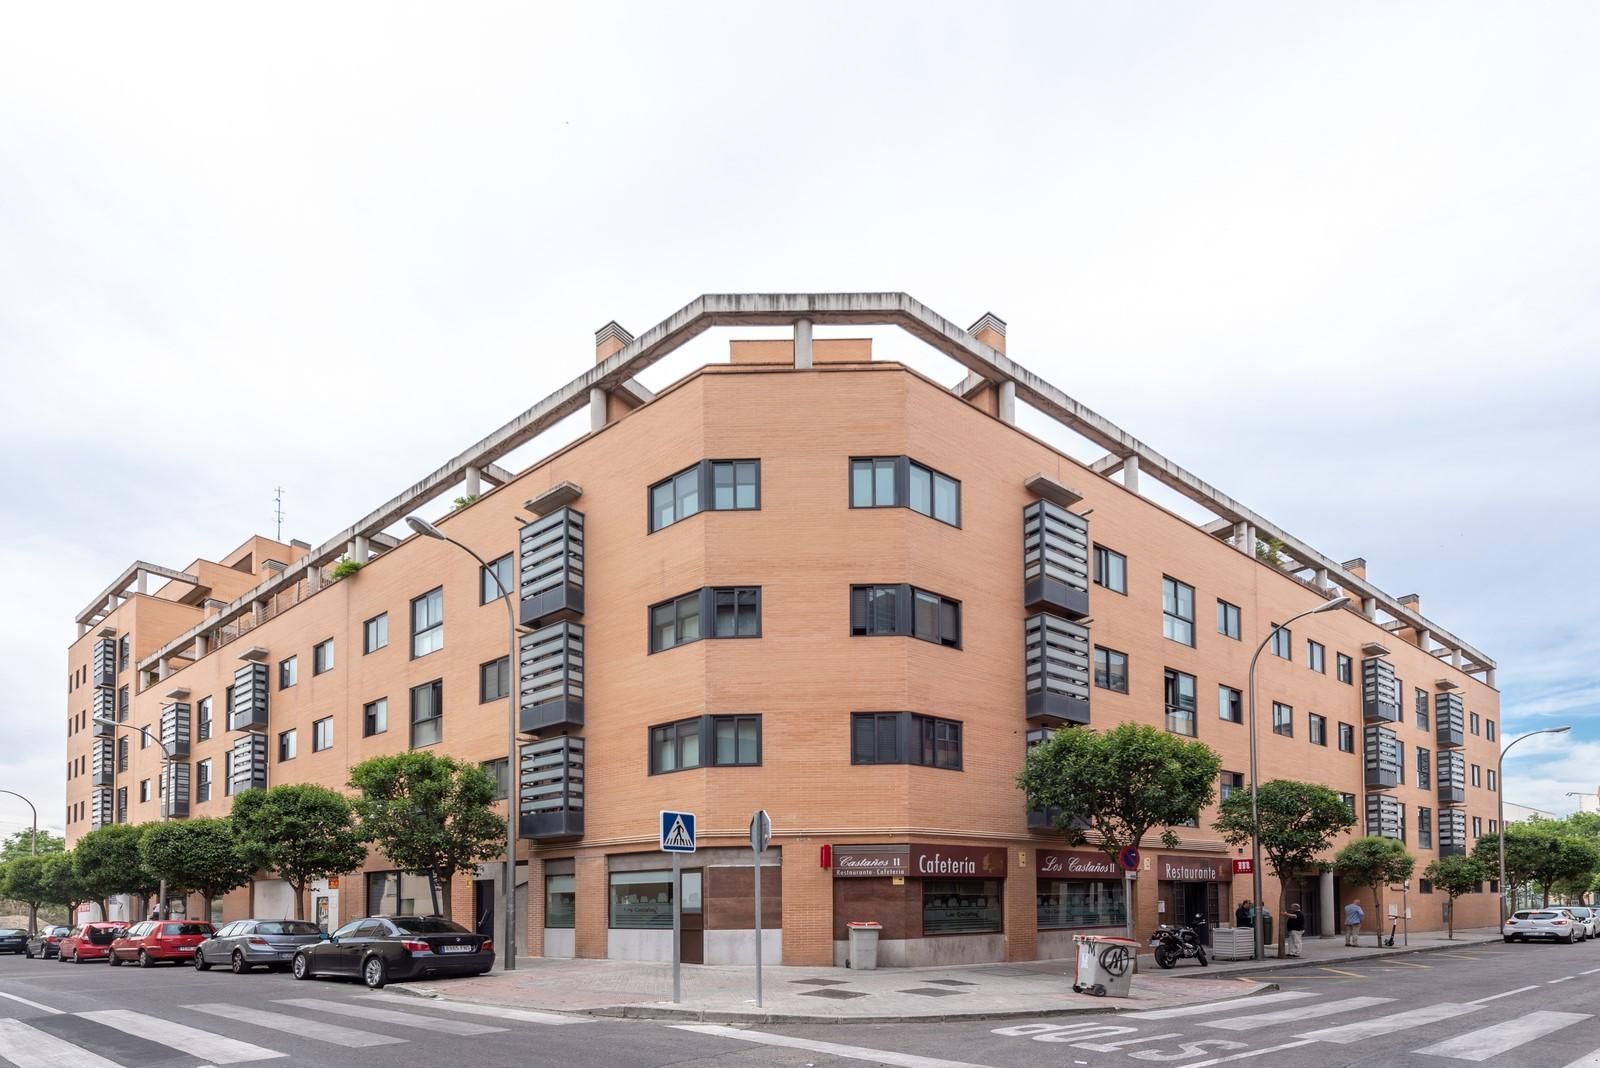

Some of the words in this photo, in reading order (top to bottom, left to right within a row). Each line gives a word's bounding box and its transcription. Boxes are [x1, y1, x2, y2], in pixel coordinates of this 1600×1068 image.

[839, 855, 889, 867] Castaños
[919, 853, 976, 874] Cafetería
[1041, 856, 1062, 872] Los
[1068, 857, 1109, 872] Castaños
[1165, 863, 1216, 879] Restaurante
